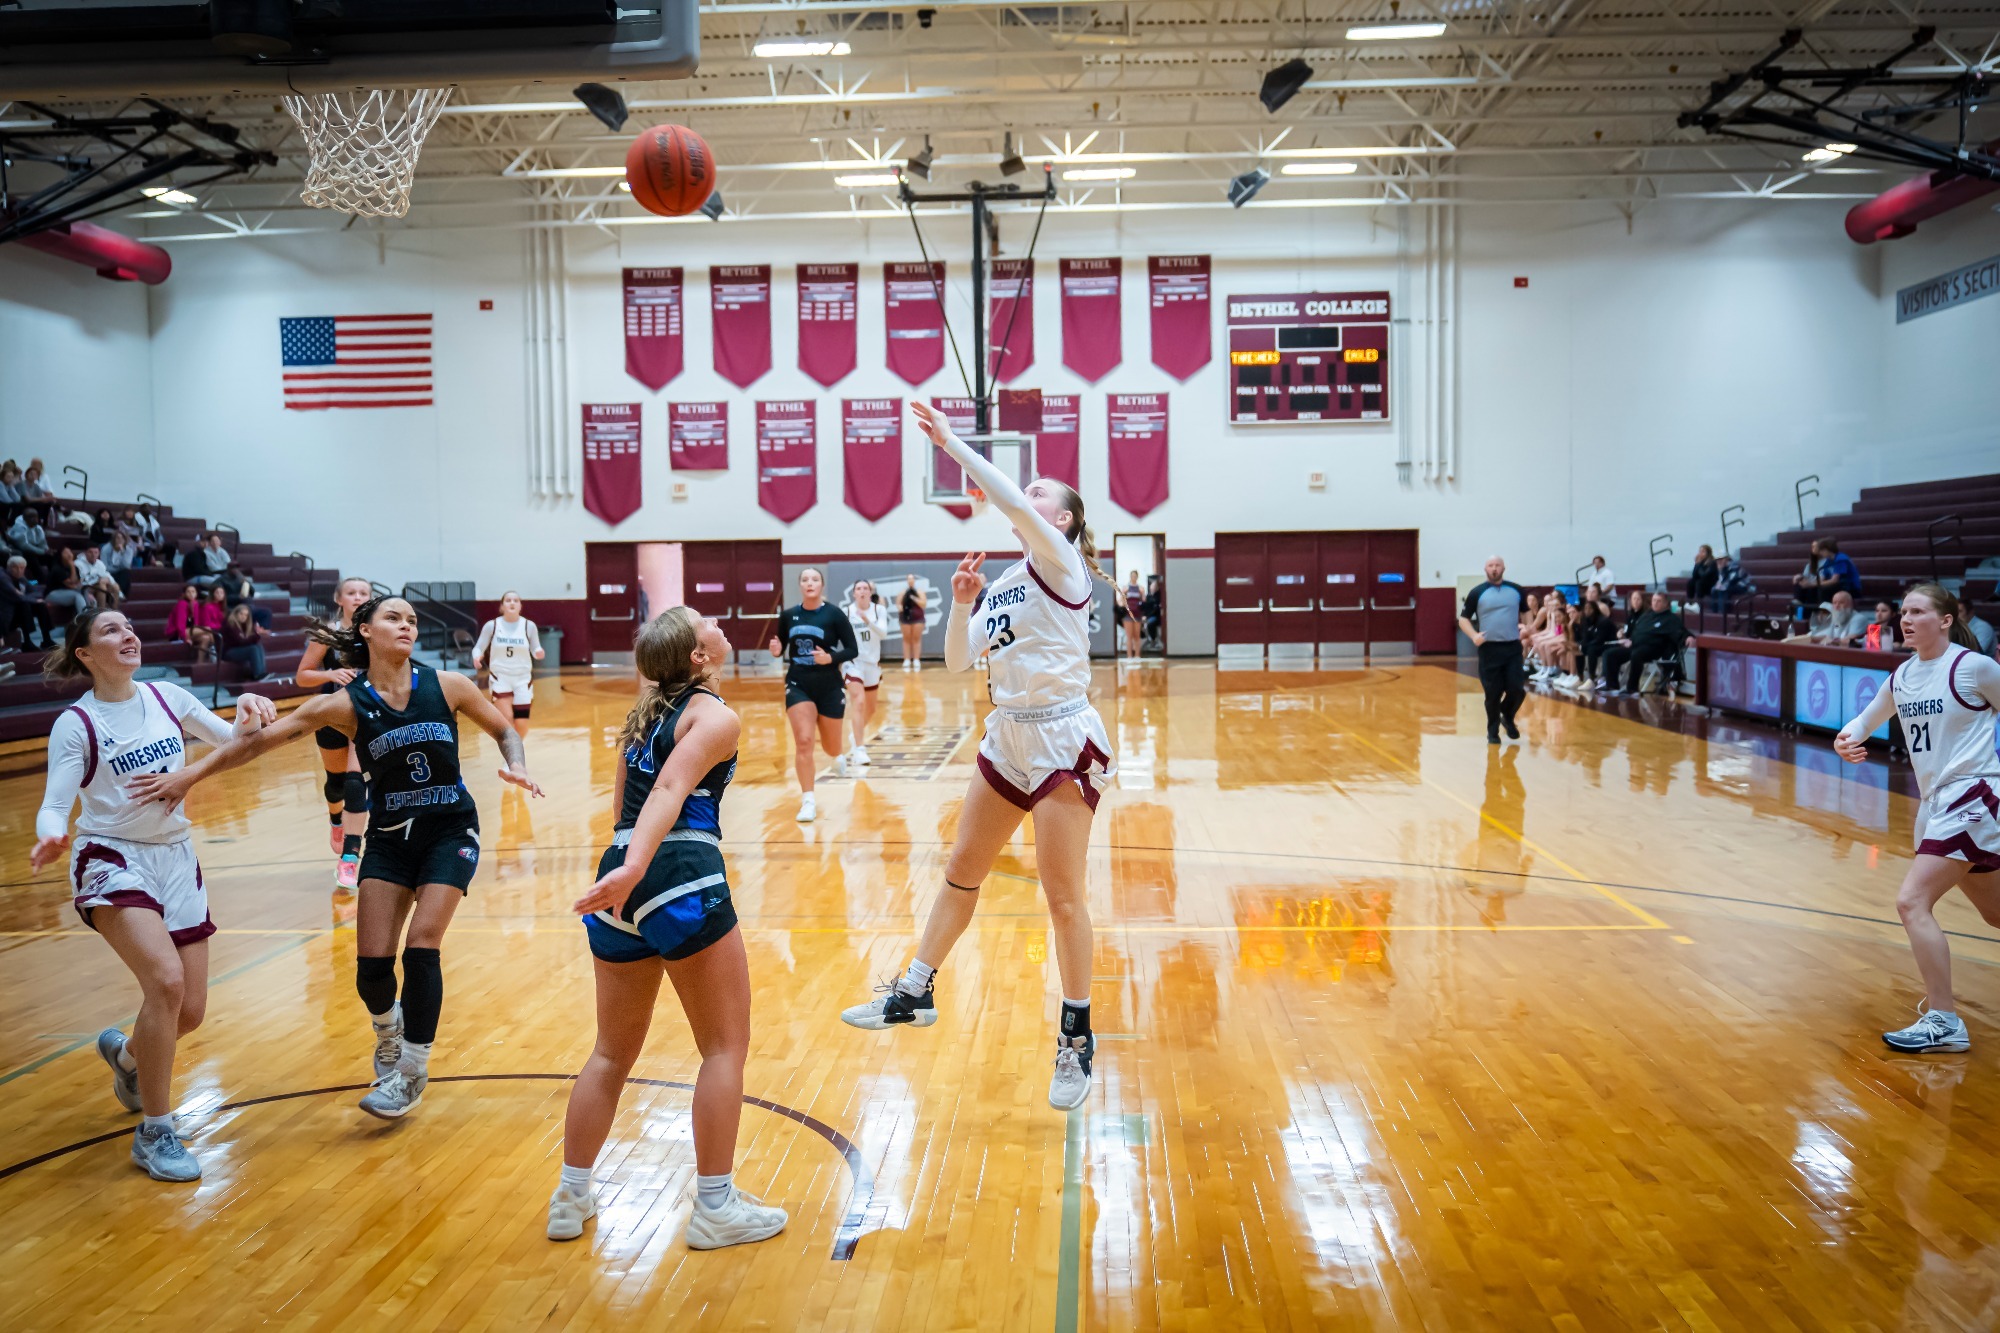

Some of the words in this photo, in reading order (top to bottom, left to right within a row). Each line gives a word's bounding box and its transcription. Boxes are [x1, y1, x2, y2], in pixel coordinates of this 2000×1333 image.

[1159, 258, 1200, 267] BETHEL
[632, 269, 673, 279] BETHEL
[720, 266, 760, 277] BETHEL
[807, 265, 848, 275] BETHEL
[1902, 275, 1960, 315] VISITOR'S
[1230, 301, 1299, 317] BETHEL
[1305, 299, 1388, 316] COLLEGE
[852, 400, 893, 411] BETHEL
[941, 399, 976, 409] BETHE
[1117, 395, 1159, 406] BETHEL
[591, 405, 632, 415] BETHEL
[678, 403, 718, 414] BETHEL
[766, 402, 806, 412] BETHEL
[860, 630, 871, 642] 10
[986, 613, 1016, 651] 23
[506, 646, 514, 658] 5
[1716, 658, 1740, 701] BC
[1752, 663, 1779, 708] BC
[1898, 698, 1943, 719] THRESHERS
[1910, 721, 1931, 753] 21
[109, 736, 181, 776] THRESHERS
[406, 751, 432, 783] 3
